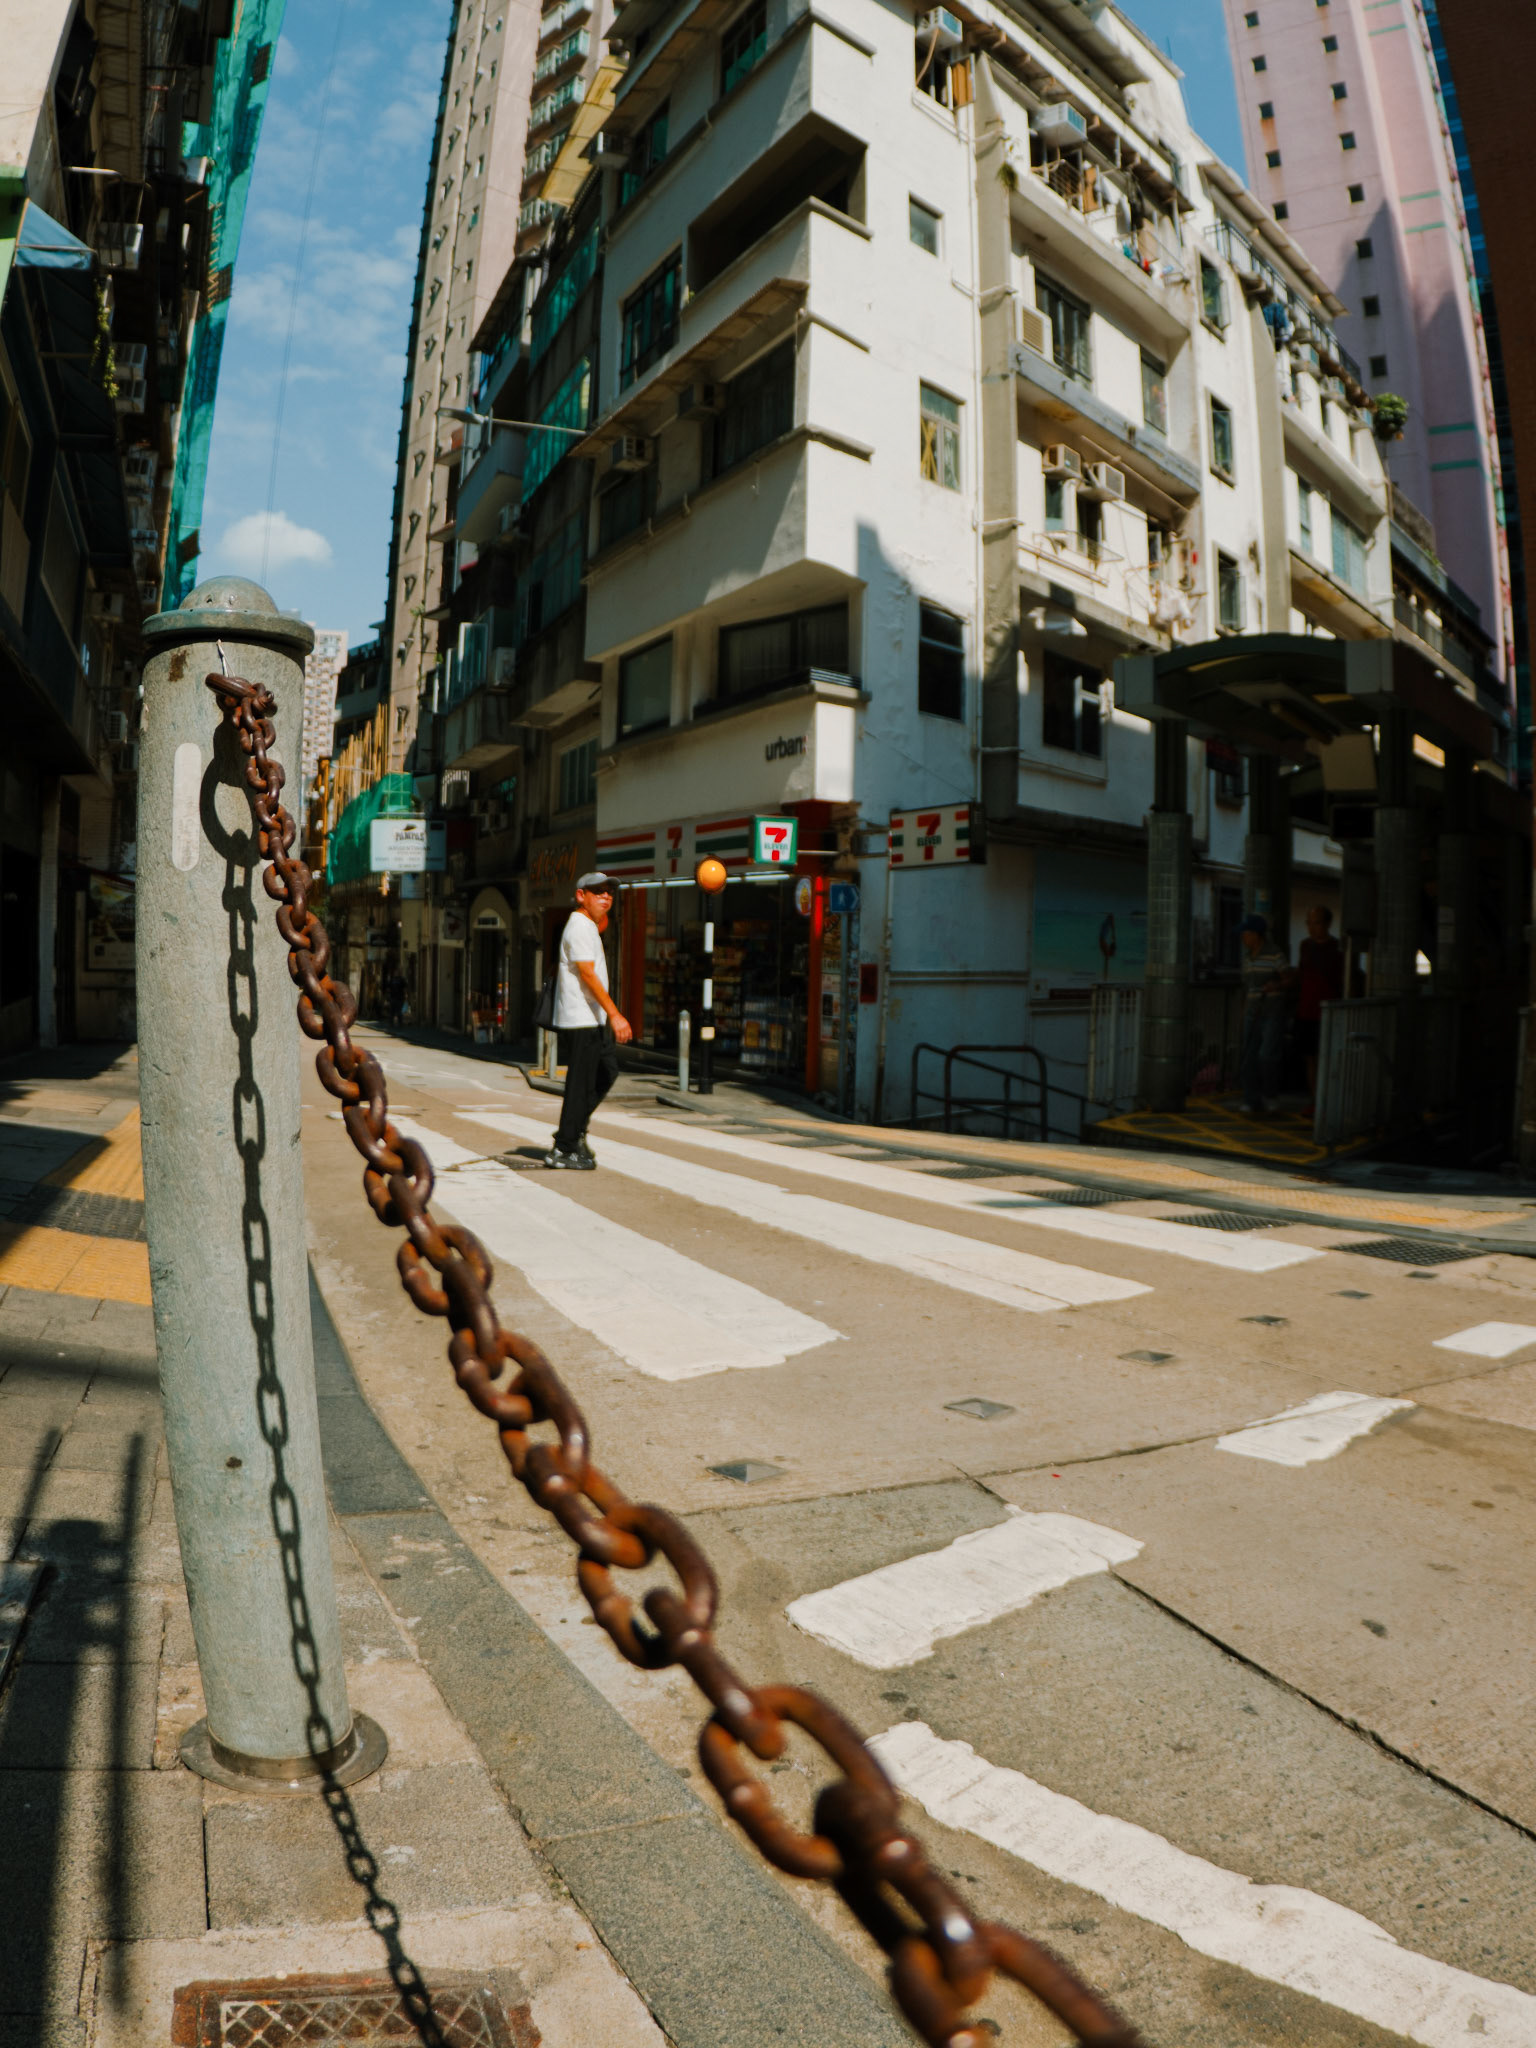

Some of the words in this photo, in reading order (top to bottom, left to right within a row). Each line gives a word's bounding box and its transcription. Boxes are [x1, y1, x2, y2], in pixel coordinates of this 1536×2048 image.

[667, 825, 682, 874] 7
[765, 827, 787, 861] 7
[916, 813, 942, 861] 7
